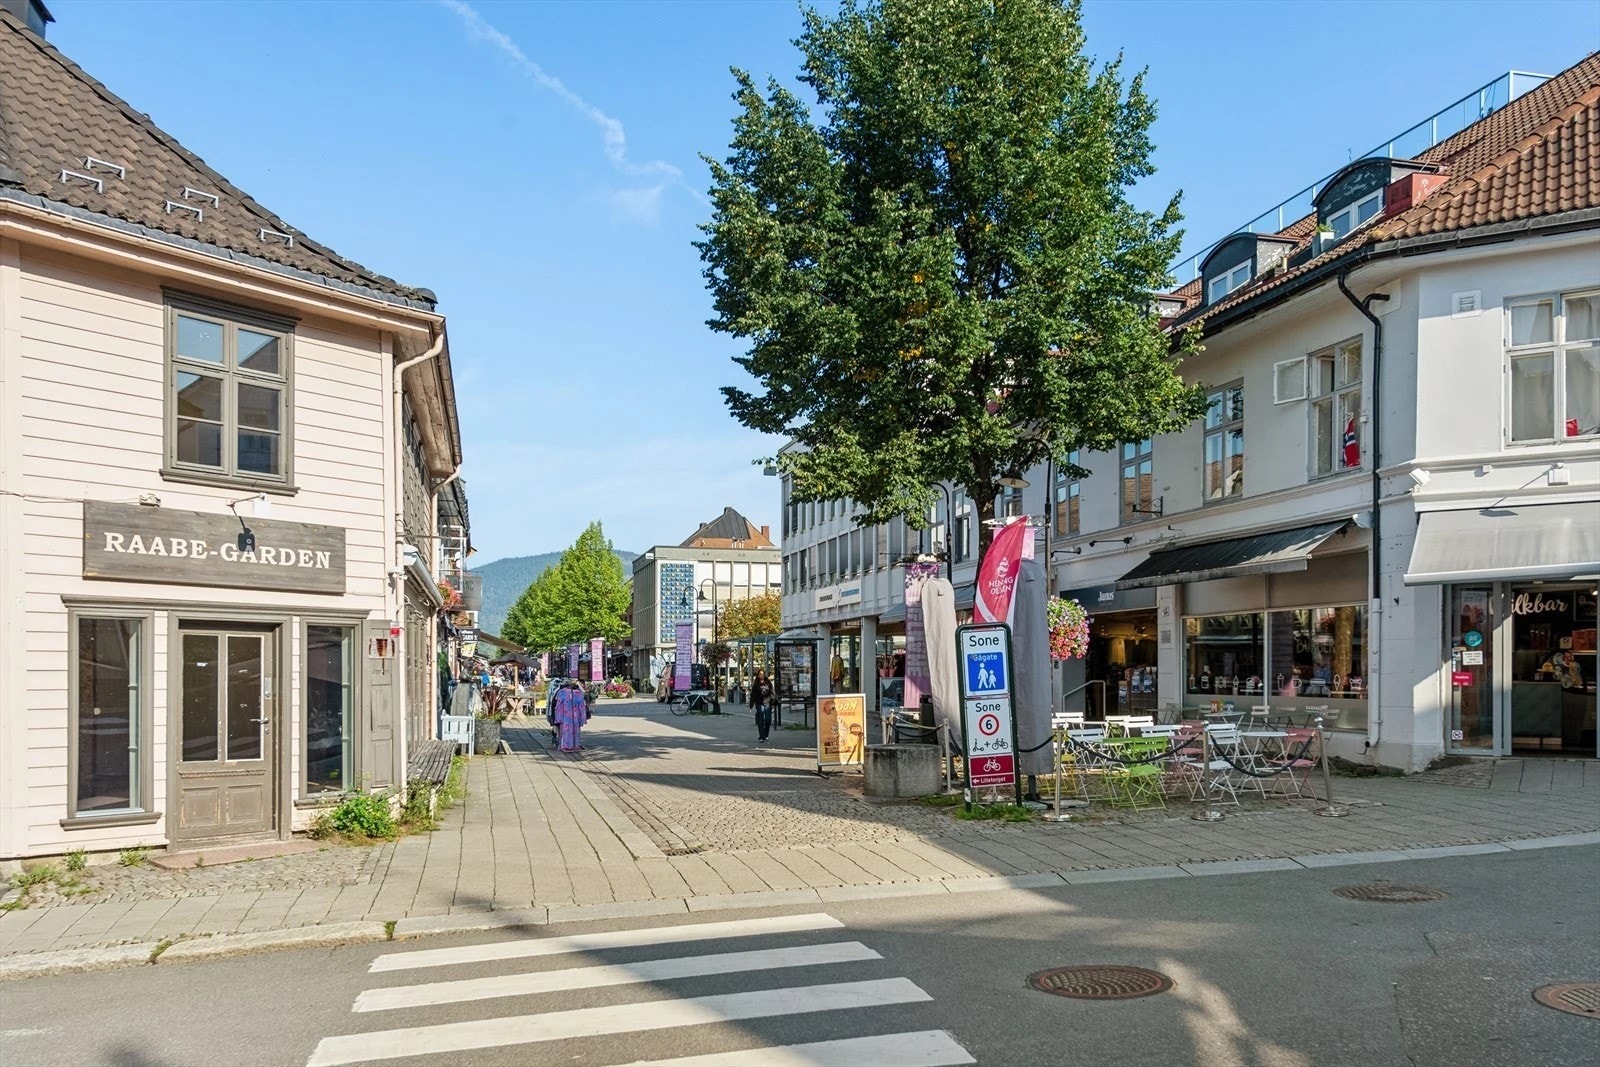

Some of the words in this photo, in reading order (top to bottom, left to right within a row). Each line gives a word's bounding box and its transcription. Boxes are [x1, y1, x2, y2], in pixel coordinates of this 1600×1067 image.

[103, 531, 332, 569] RAABE-GARDEN
[1098, 591, 1115, 602] Janus
[969, 635, 1000, 647] Sone
[975, 702, 1001, 713] Sone
[985, 719, 993, 731] 6
[980, 776, 1006, 784] Lilletorget
